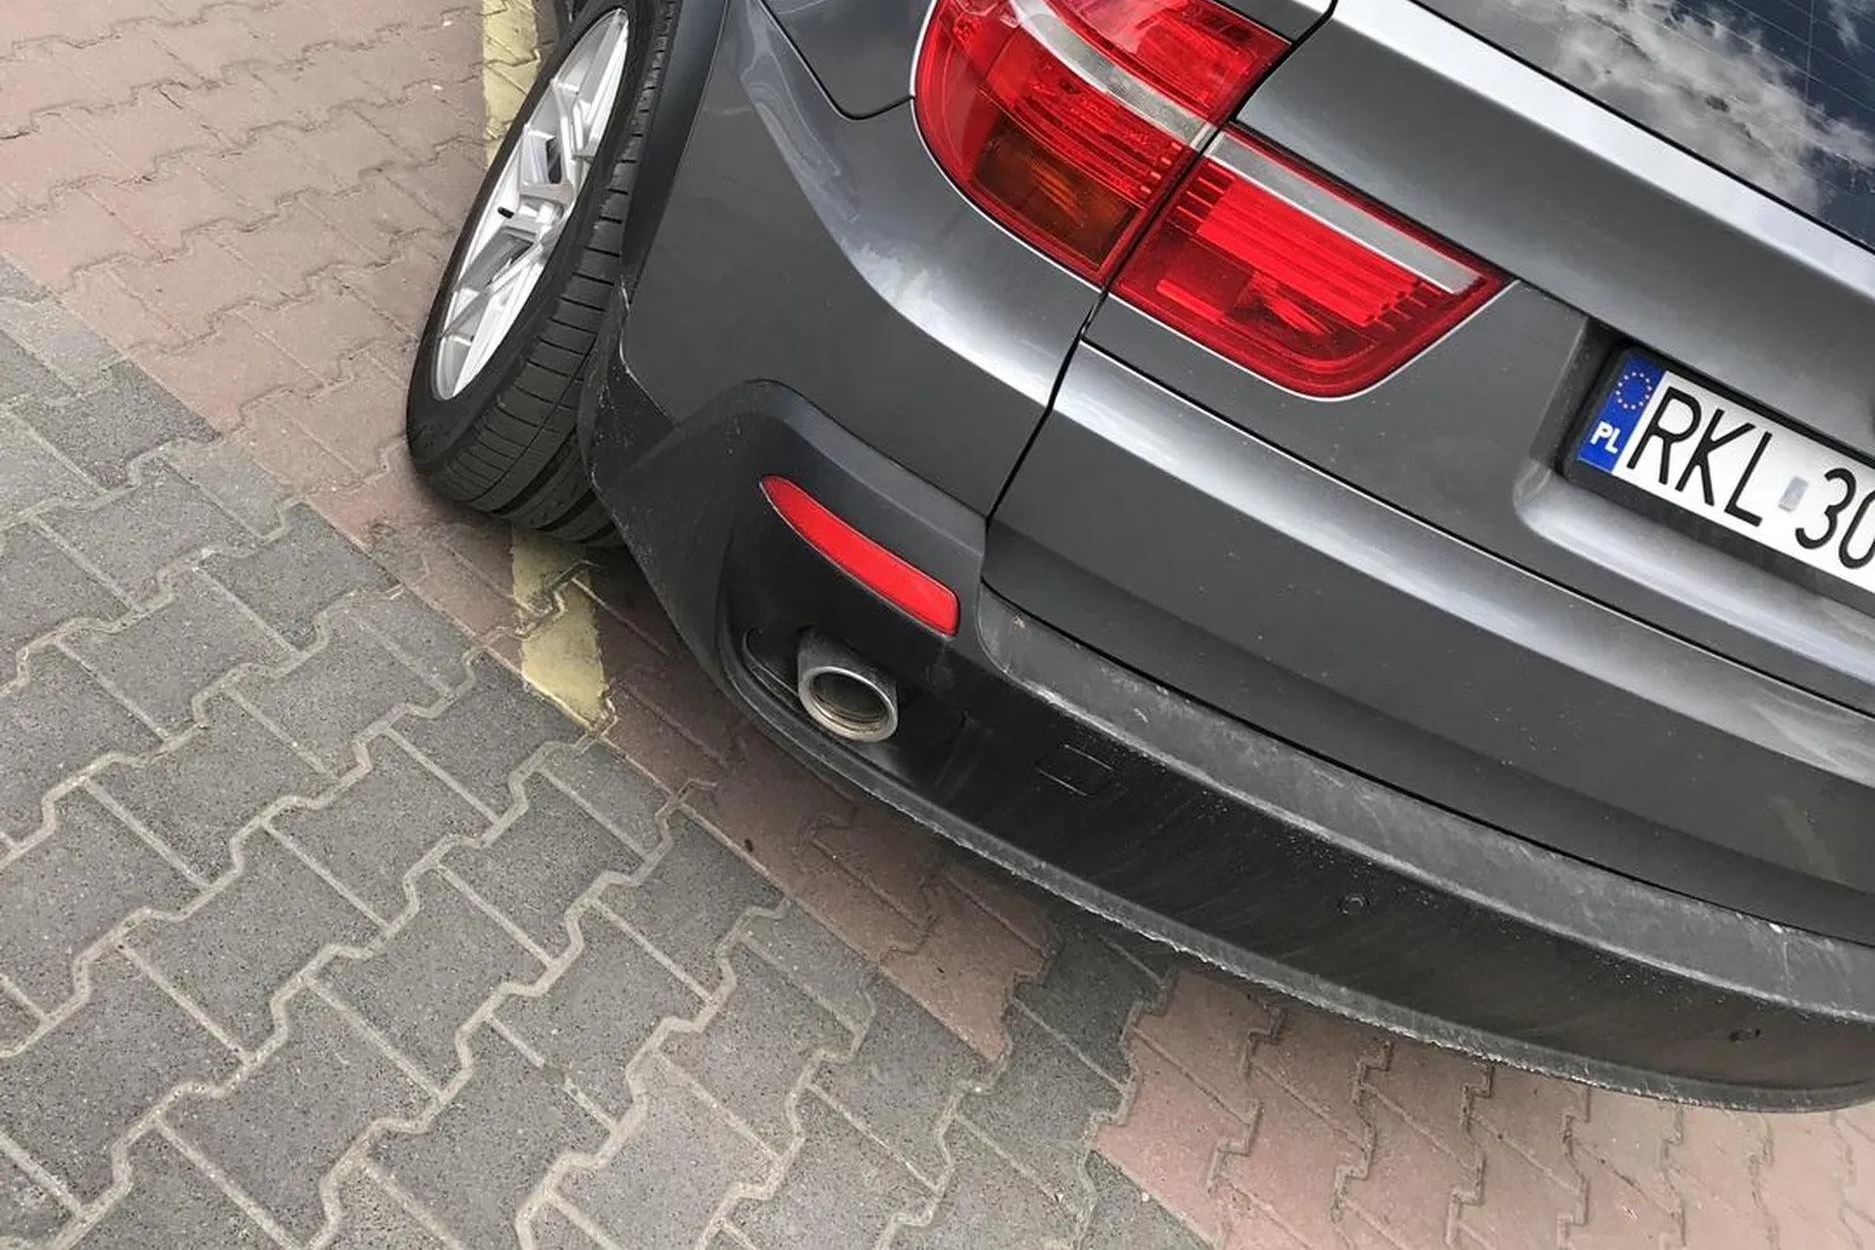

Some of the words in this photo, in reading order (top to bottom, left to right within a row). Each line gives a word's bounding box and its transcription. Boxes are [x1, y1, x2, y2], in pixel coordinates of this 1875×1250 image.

[1589, 420, 1619, 454] PL
[1626, 386, 1773, 528] RKL
[1794, 467, 1875, 570] 30
